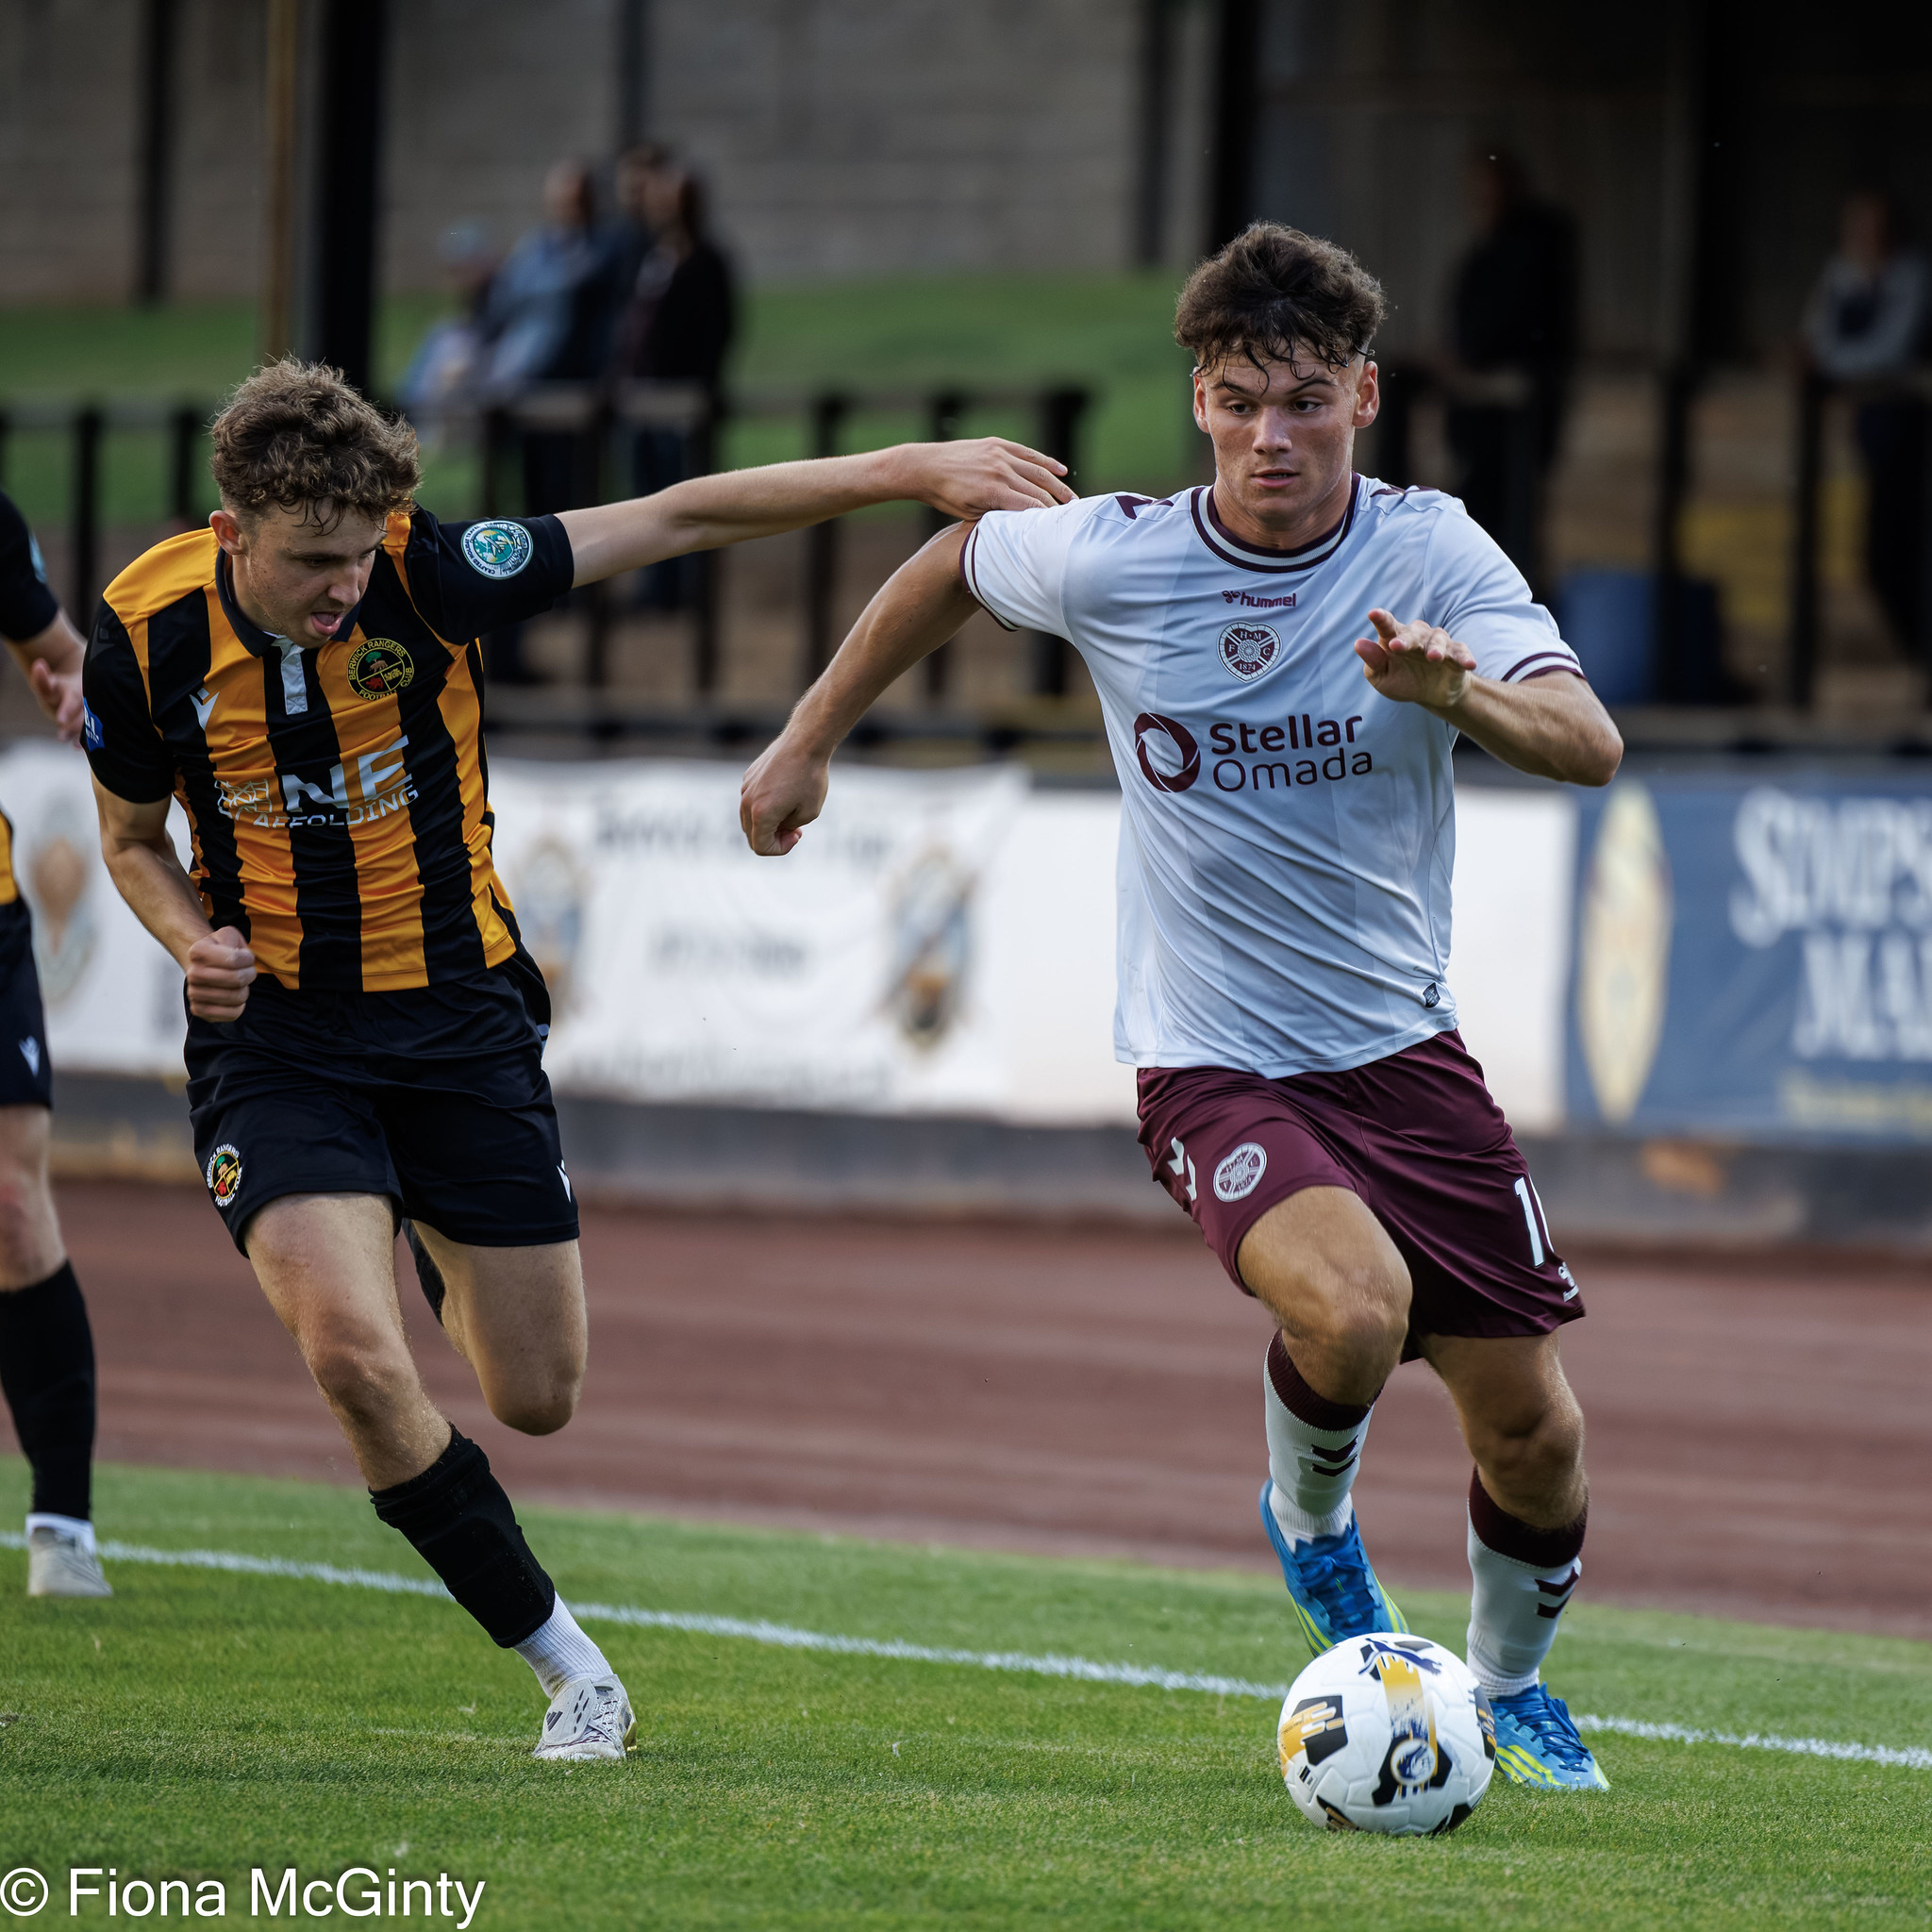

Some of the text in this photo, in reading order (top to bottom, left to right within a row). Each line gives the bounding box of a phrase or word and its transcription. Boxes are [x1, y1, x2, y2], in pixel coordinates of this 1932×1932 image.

[1240, 591, 1297, 608] hummel
[348, 640, 406, 680] BERWICK RANGERS
[1239, 662, 1256, 672] 1874
[358, 667, 412, 701] FOOT CLUB
[1209, 714, 1363, 756] Stellar
[1213, 748, 1373, 792] Omada
